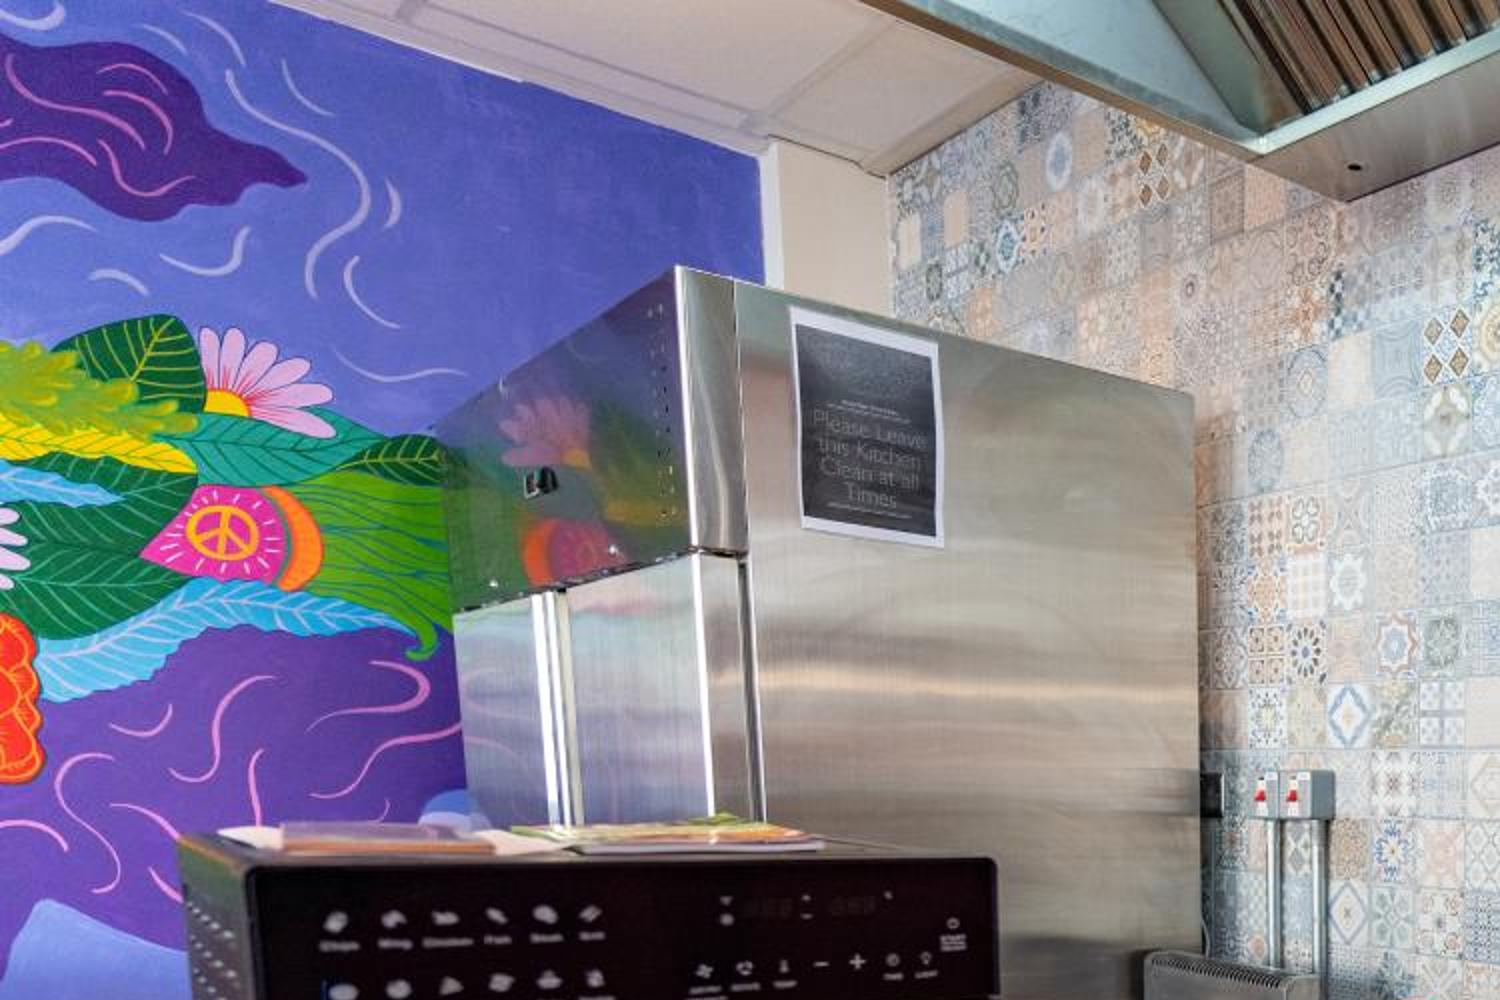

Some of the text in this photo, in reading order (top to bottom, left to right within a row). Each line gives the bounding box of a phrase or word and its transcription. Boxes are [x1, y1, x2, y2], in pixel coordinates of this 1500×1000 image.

[814, 408, 873, 439] Please
[876, 424, 929, 450] Leave
[818, 436, 921, 472] this Kitchen
[820, 454, 920, 491] Clean at all
[846, 482, 898, 509] Times
